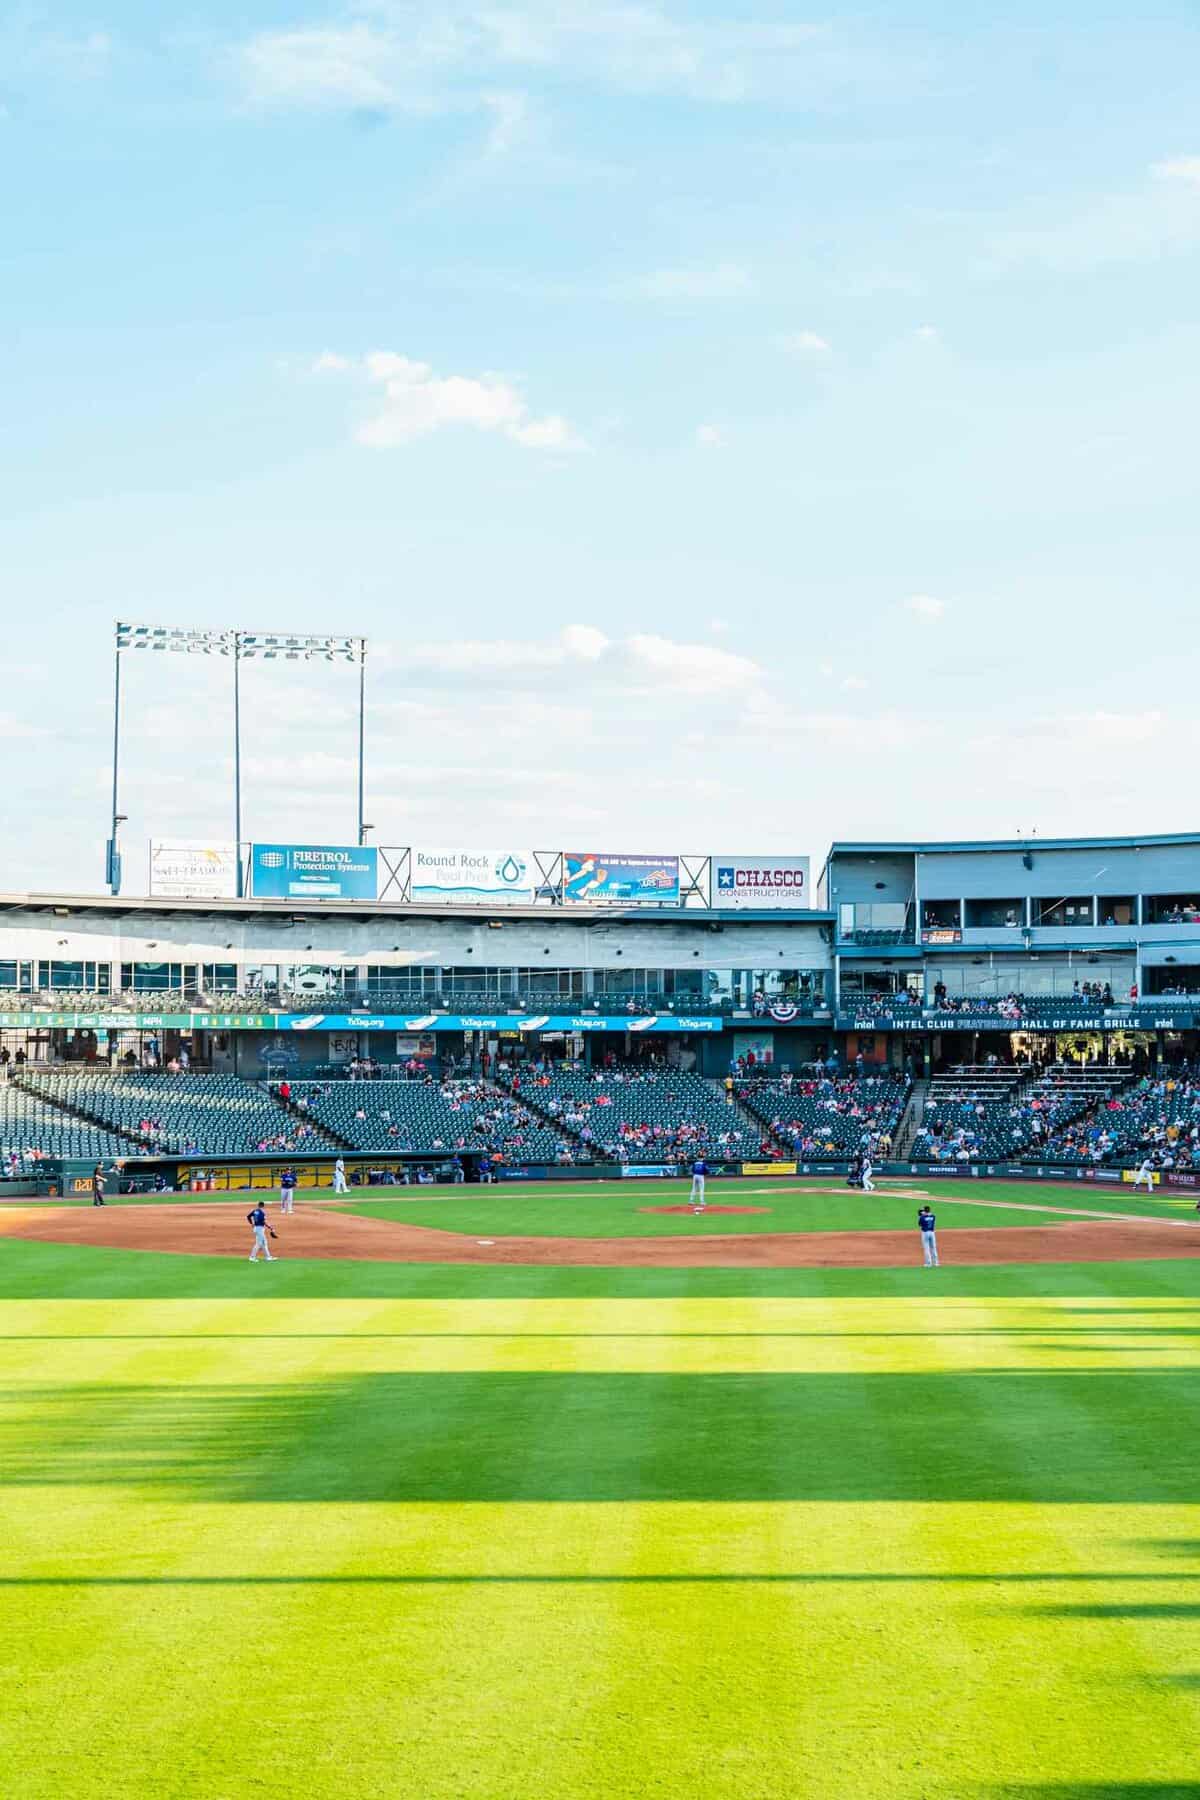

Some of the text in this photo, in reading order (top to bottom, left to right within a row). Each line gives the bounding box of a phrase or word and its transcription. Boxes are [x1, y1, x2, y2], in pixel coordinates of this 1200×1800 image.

[293, 851, 352, 863] FIRETROL
[417, 853, 489, 868] Round Rock
[293, 862, 370, 873] Protection Systems
[735, 870, 804, 887] CHASCO
[718, 889, 802, 897] CONSTRUCTORS
[893, 1020, 924, 1029] INTEL
[927, 1020, 954, 1029] CLUB
[1022, 1020, 1049, 1028] HALL
[1052, 1020, 1067, 1028] OF
[1070, 1020, 1100, 1028] FAME
[1104, 1019, 1141, 1028] GRILLE
